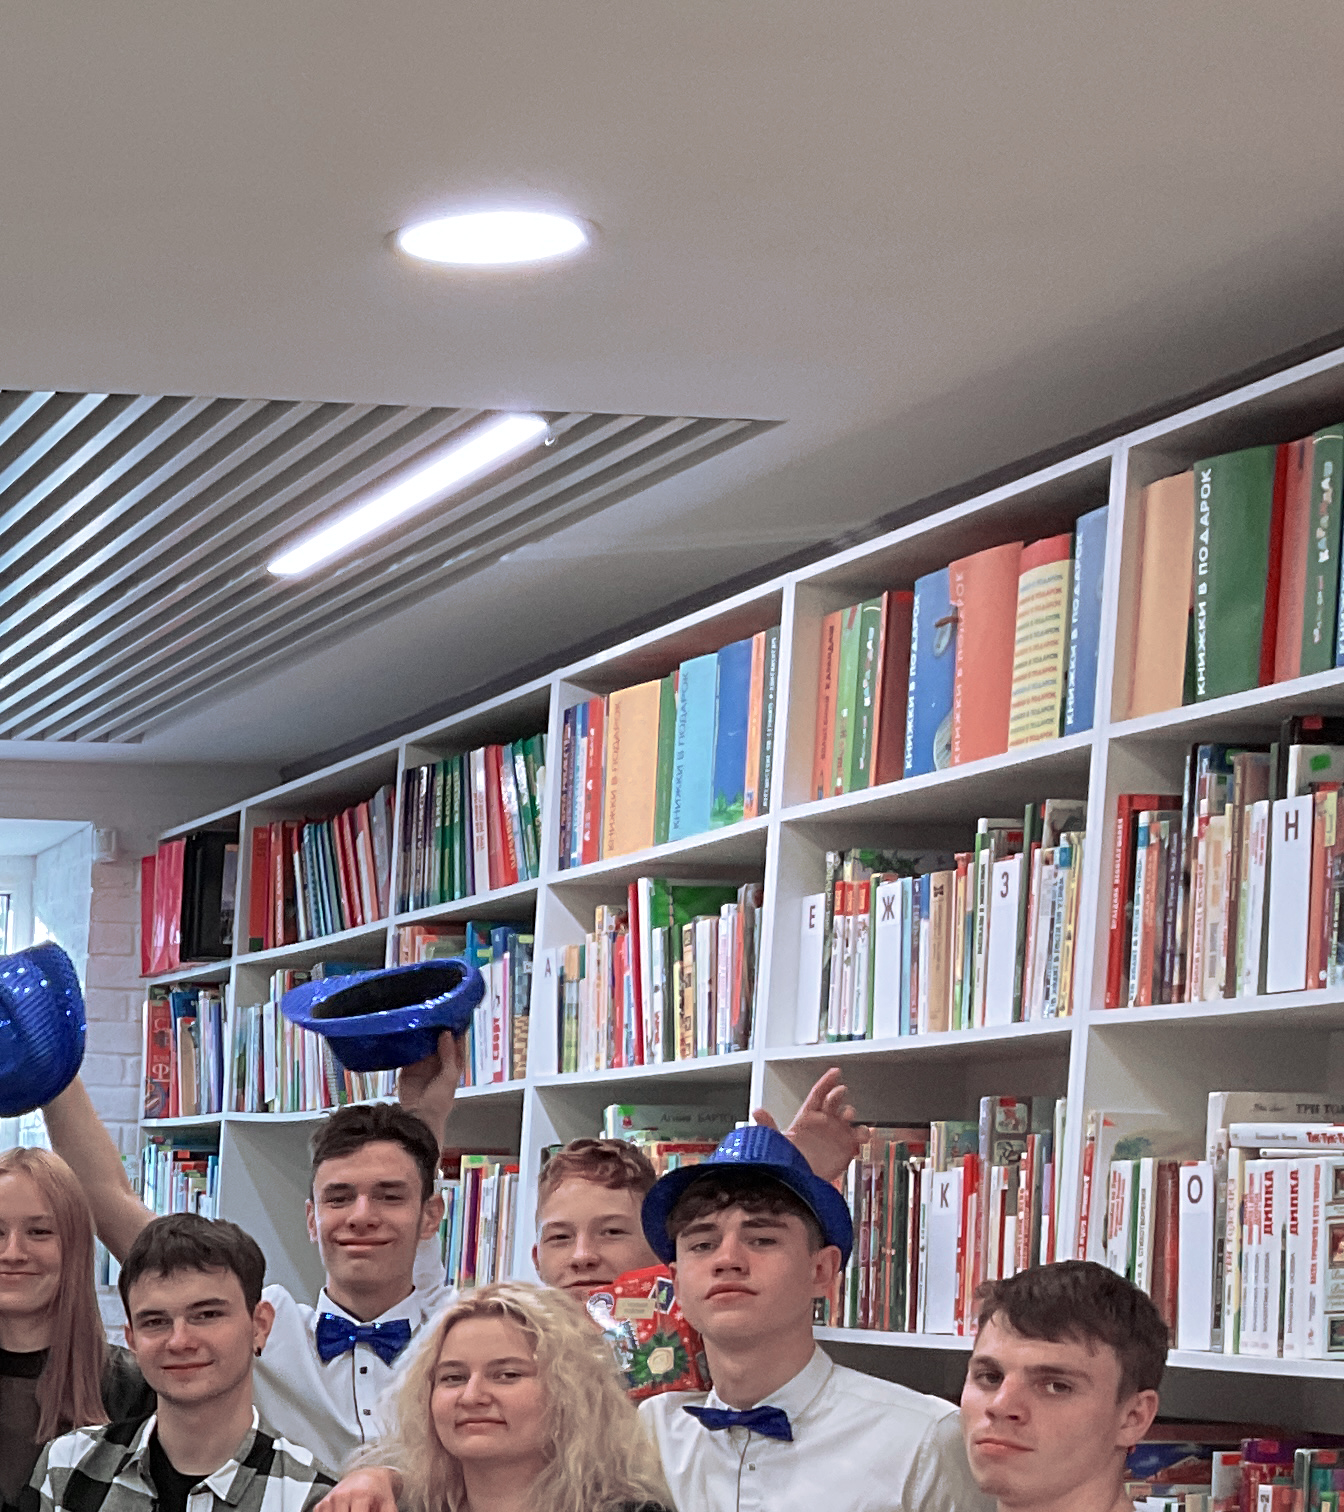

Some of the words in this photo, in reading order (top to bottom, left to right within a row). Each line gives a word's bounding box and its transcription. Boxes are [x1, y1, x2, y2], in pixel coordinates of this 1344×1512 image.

[1197, 467, 1213, 576] ПОДАРОК
[1071, 531, 1083, 623] ПОДАРОК
[1198, 582, 1209, 595] В
[909, 594, 921, 677] ПОДАРОК
[1196, 601, 1208, 696] КНИЖКИ
[678, 671, 689, 745] ПОДАРОК
[1066, 646, 1077, 725] КНИЖКИ
[611, 701, 622, 772] ПОДАРОК
[905, 696, 916, 769] КНИЖКИ
[607, 789, 618, 852] КНИЖКИ
[673, 764, 684, 830] КНИЖКИ
[1285, 810, 1299, 842] Н
[808, 904, 816, 929] Е
[882, 894, 896, 922] Ж
[545, 957, 552, 978] А
[940, 1182, 950, 1208] К
[1187, 1174, 1204, 1204] О
[1263, 1170, 1273, 1236] ДИНКА
[1289, 1169, 1299, 1236] ДИНКА
